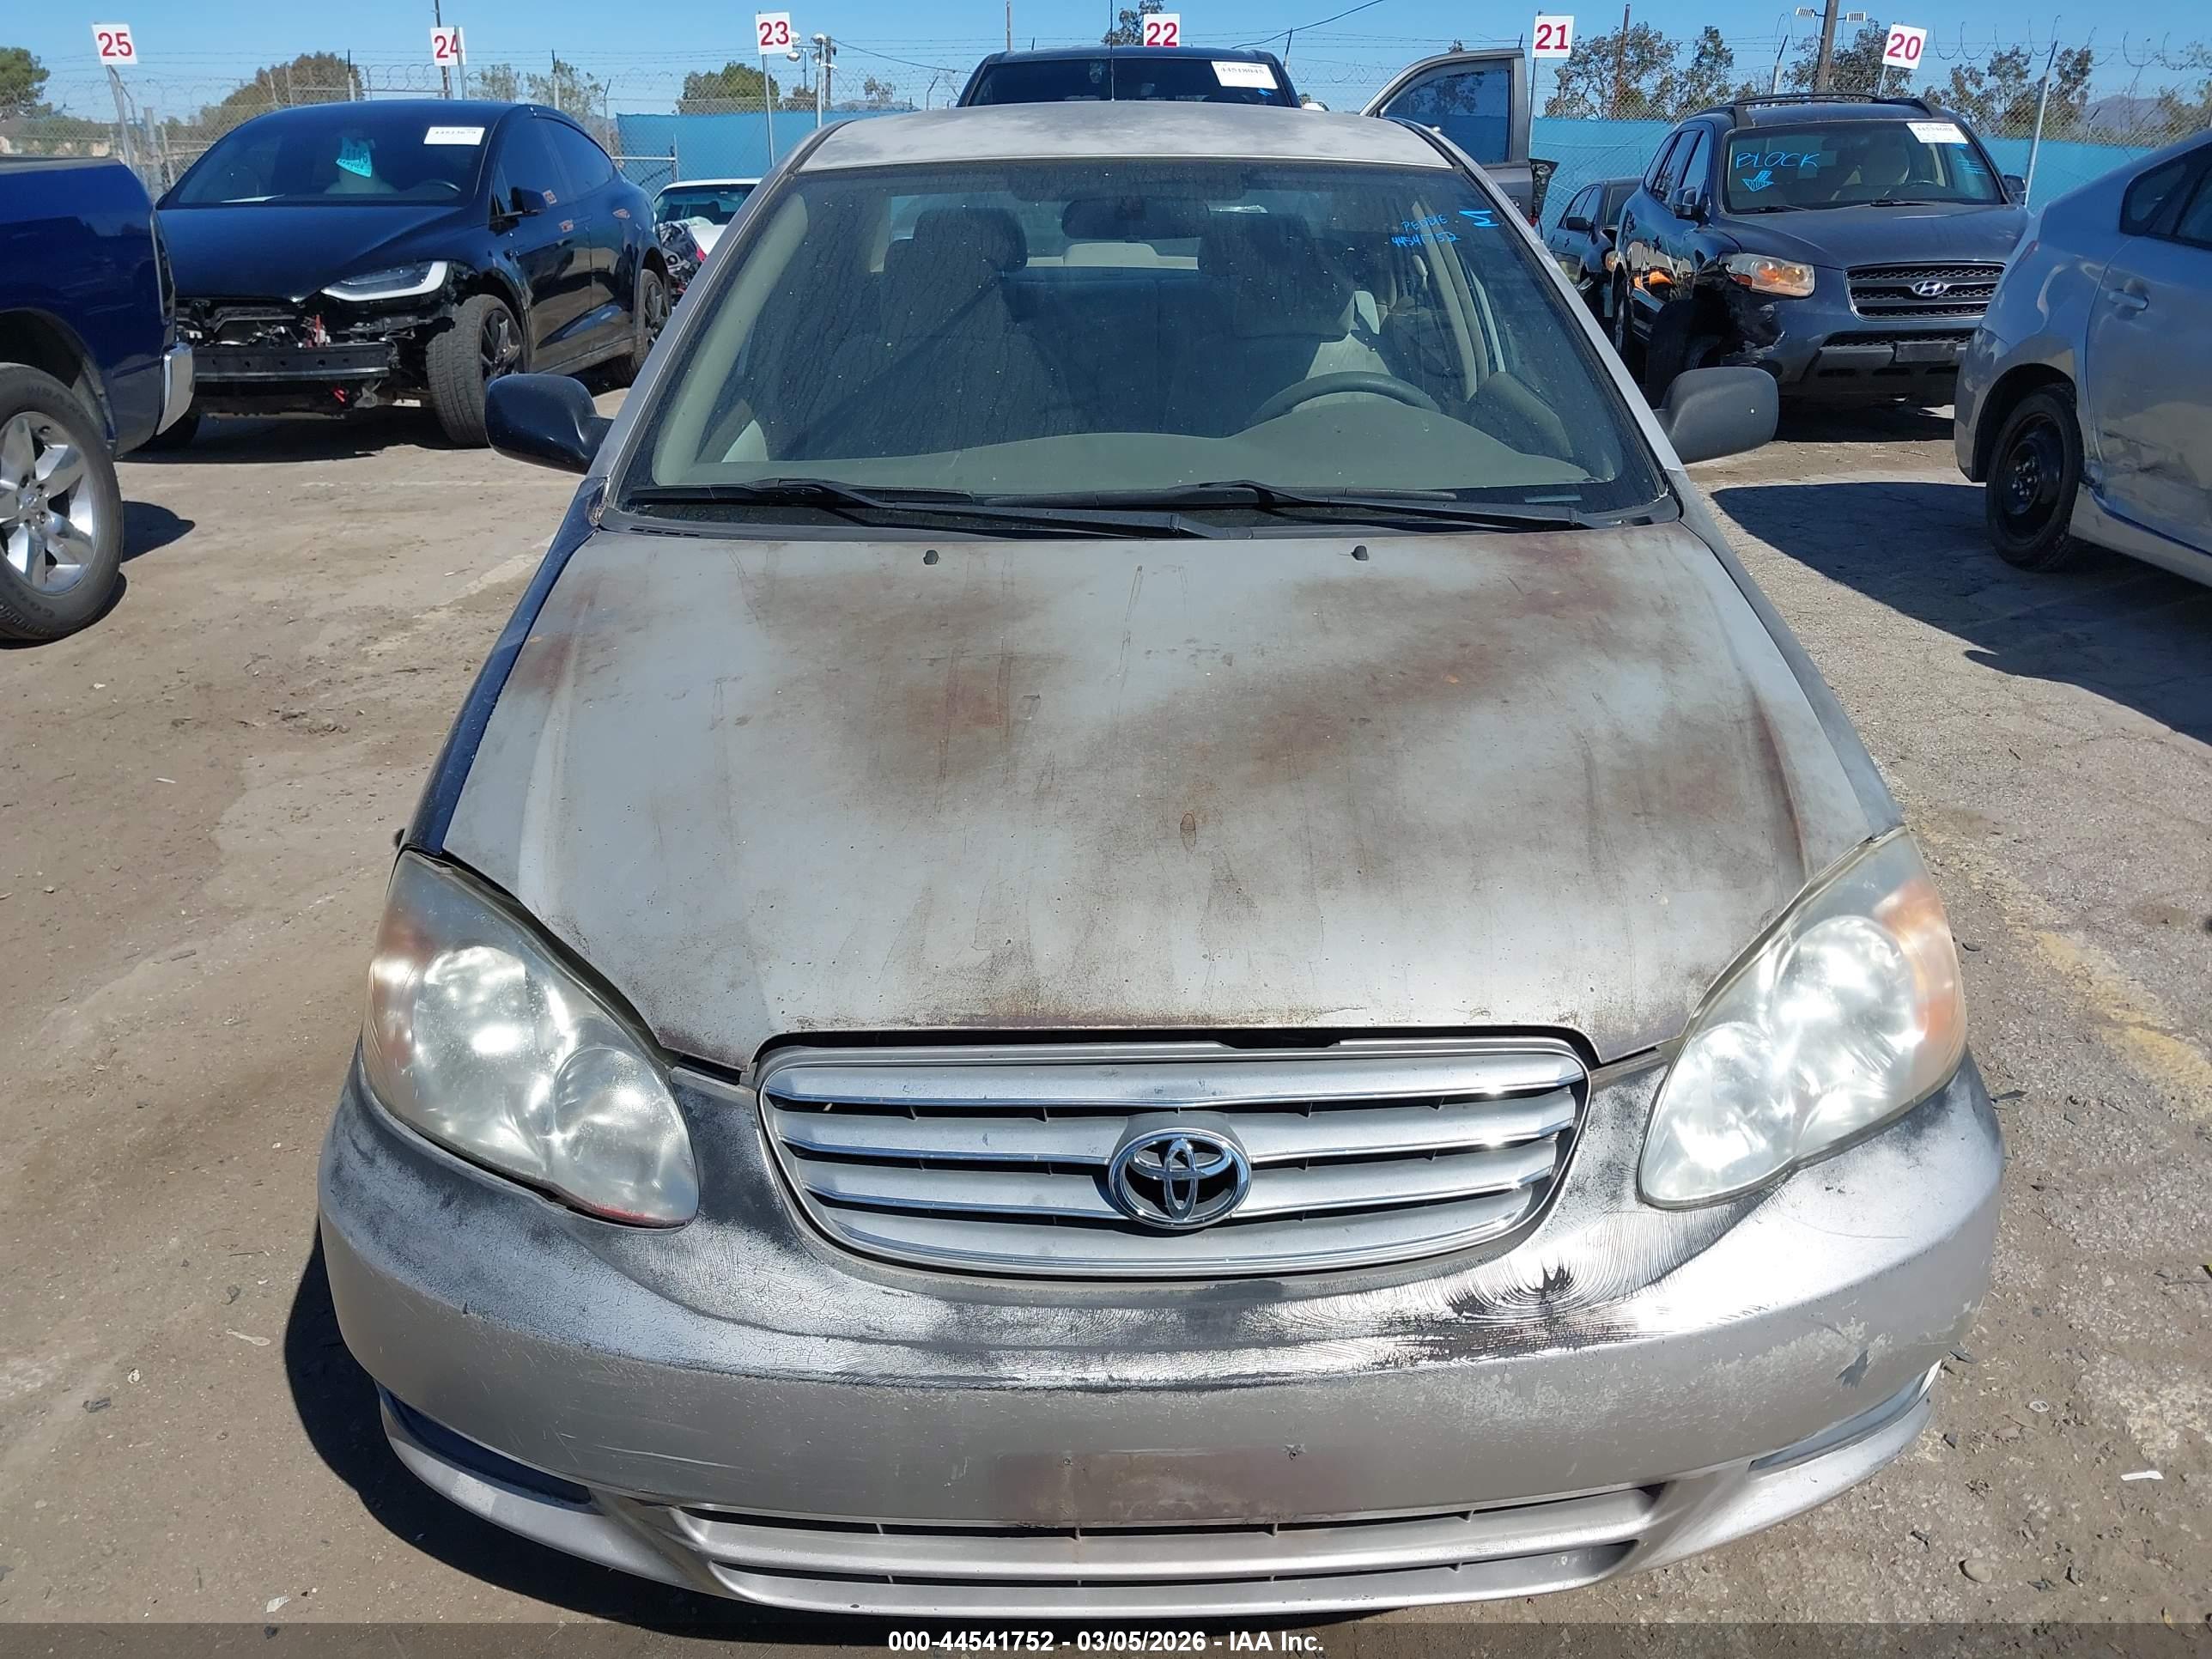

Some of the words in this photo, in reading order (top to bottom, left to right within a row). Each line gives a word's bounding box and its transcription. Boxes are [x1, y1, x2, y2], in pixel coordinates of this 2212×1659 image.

[98, 32, 132, 57] 25
[759, 21, 789, 46] 23
[1146, 22, 1177, 46] 22
[1534, 23, 1569, 50] 21
[434, 34, 463, 58] 24
[1887, 33, 1921, 61] 20
[1735, 151, 1820, 169] BLOCK
[1391, 231, 1462, 247] 44541752
